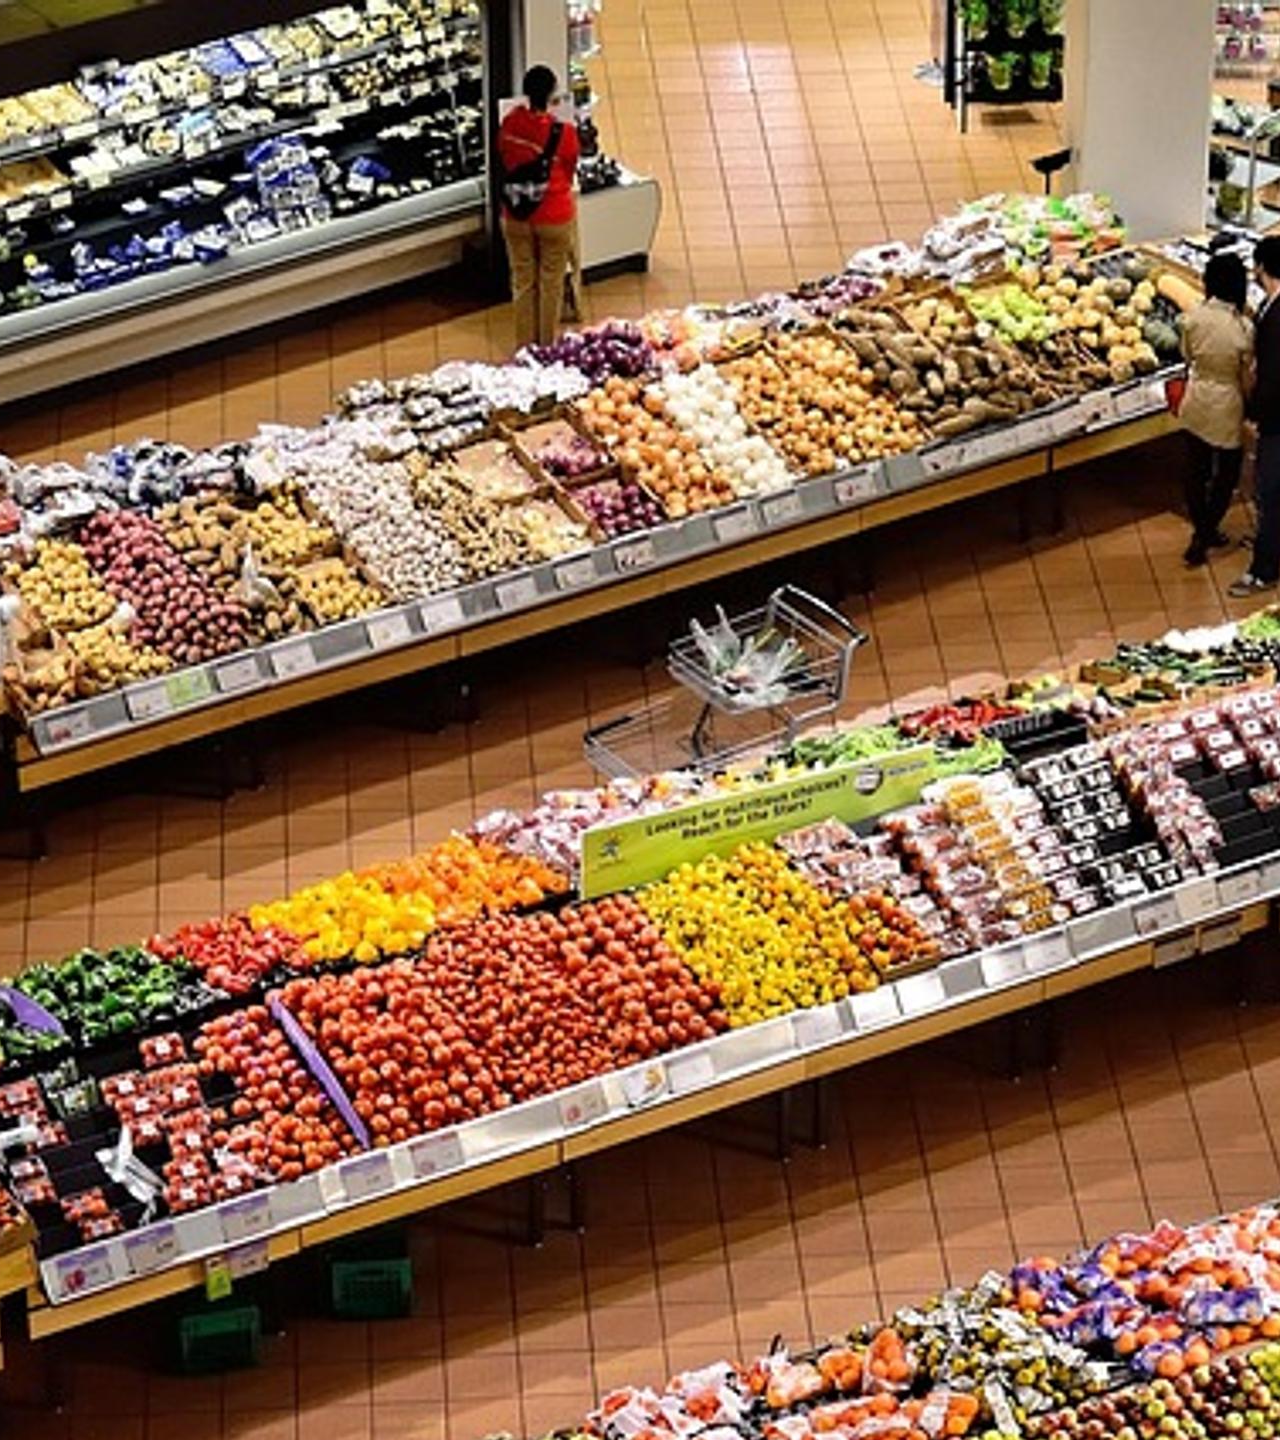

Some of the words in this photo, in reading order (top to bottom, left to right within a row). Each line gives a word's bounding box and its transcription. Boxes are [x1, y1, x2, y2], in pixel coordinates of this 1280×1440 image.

[647, 813, 698, 836] Looking
[702, 806, 721, 821] for
[723, 791, 788, 815] nutritious
[791, 775, 847, 799] choices?
[681, 821, 722, 839] Reach
[725, 815, 744, 829] for
[747, 808, 769, 823] the
[772, 798, 813, 817] Stars!
